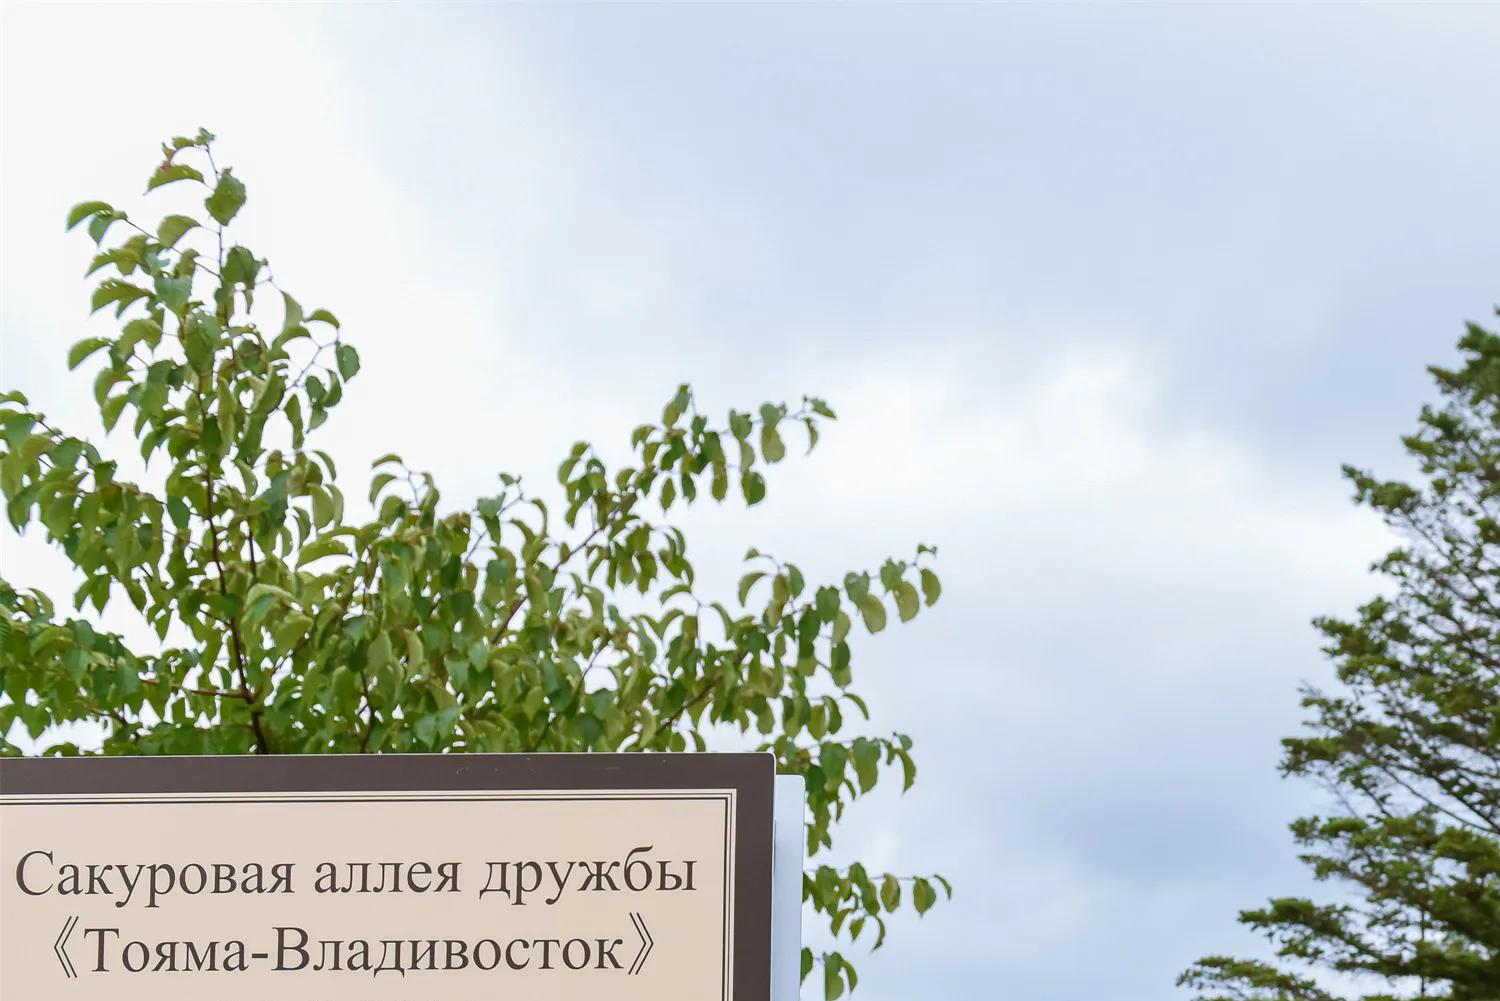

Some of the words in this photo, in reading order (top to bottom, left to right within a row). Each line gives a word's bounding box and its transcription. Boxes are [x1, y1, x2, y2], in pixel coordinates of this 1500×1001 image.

[16, 850, 296, 909] Сакуровая
[314, 861, 462, 894] аллея
[479, 845, 698, 906] дружбы
